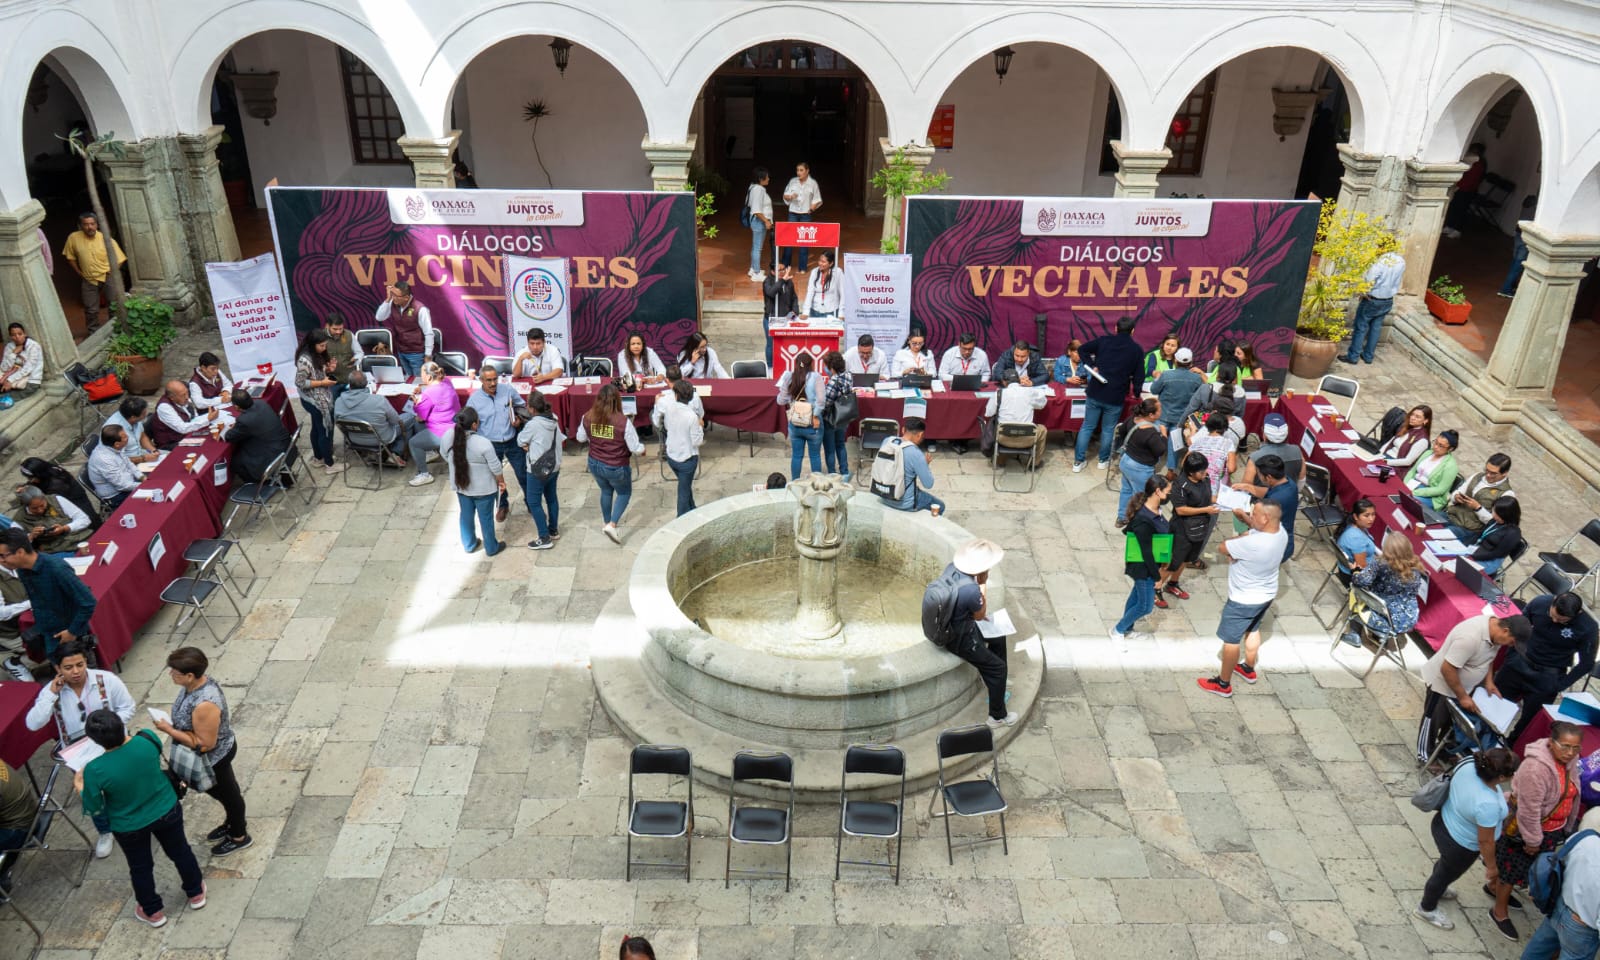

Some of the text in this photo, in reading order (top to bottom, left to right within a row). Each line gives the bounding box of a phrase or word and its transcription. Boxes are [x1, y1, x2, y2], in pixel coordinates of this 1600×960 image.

[432, 200, 475, 209] OAXACA
[506, 204, 554, 214] JUNTOS
[1063, 212, 1105, 220] OAXACA
[1135, 215, 1182, 226] JUNTOS
[437, 230, 543, 252] DIÁLOGOS
[1060, 241, 1163, 262] DIÁLOGOS
[343, 253, 639, 289] VECINES
[865, 273, 890, 282] Visita
[966, 265, 1250, 298] VECINALES
[234, 296, 265, 308] donar
[267, 294, 280, 302] de
[860, 296, 895, 305] módulo
[239, 305, 277, 317] sangre,
[524, 302, 554, 311] SALUD
[231, 316, 266, 328] ayudas
[240, 324, 270, 335] salvar
[234, 337, 252, 345] una
